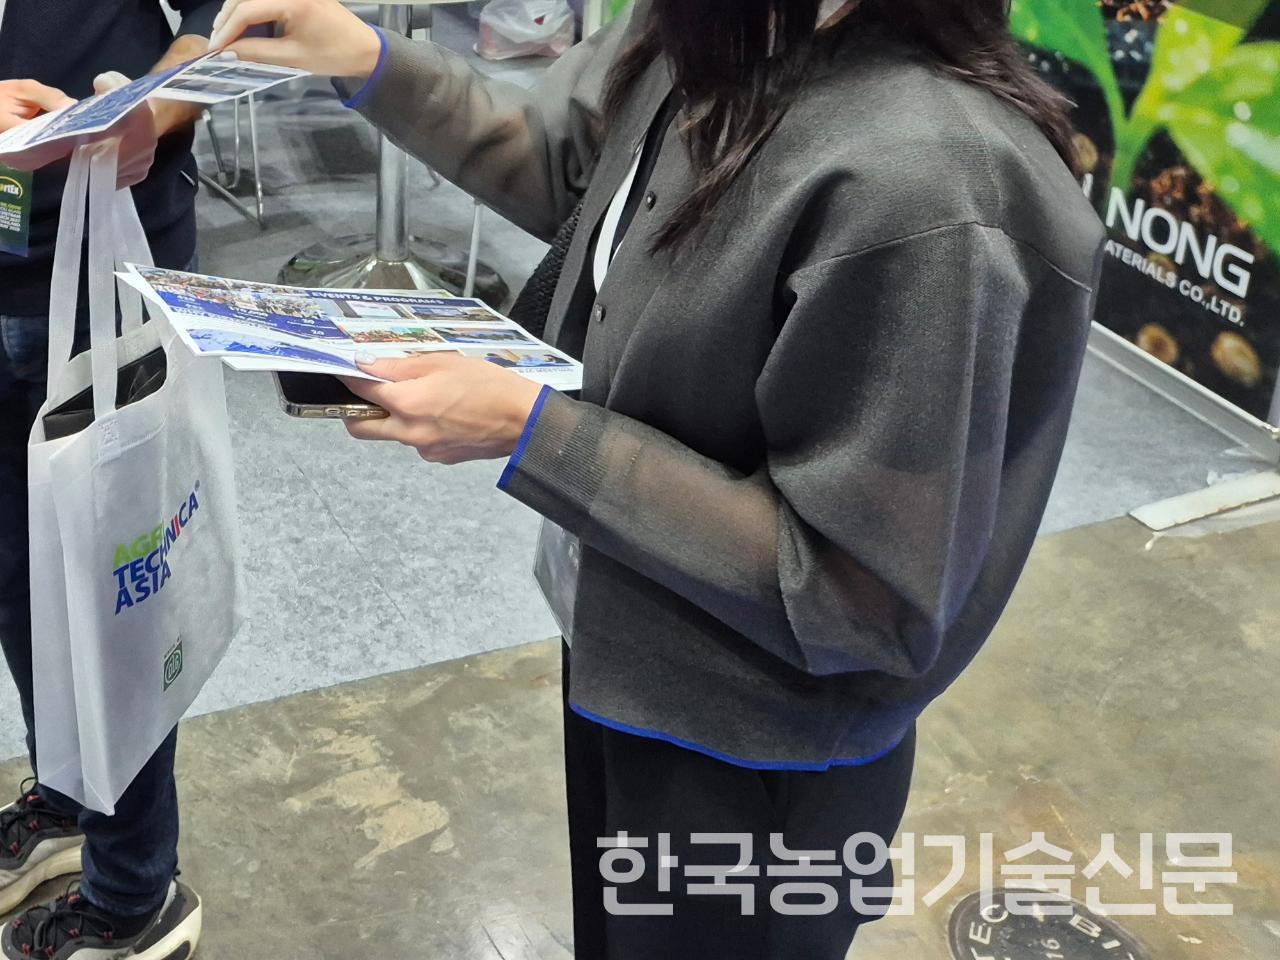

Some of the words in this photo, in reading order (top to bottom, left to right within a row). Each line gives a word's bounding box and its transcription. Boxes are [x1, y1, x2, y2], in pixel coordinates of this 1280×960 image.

[1104, 239, 1178, 290] ATERIALS
[1105, 186, 1256, 299] NONG
[113, 491, 199, 589] TECHNICA
[113, 522, 164, 569] AGR
[114, 559, 172, 617] ASIA
